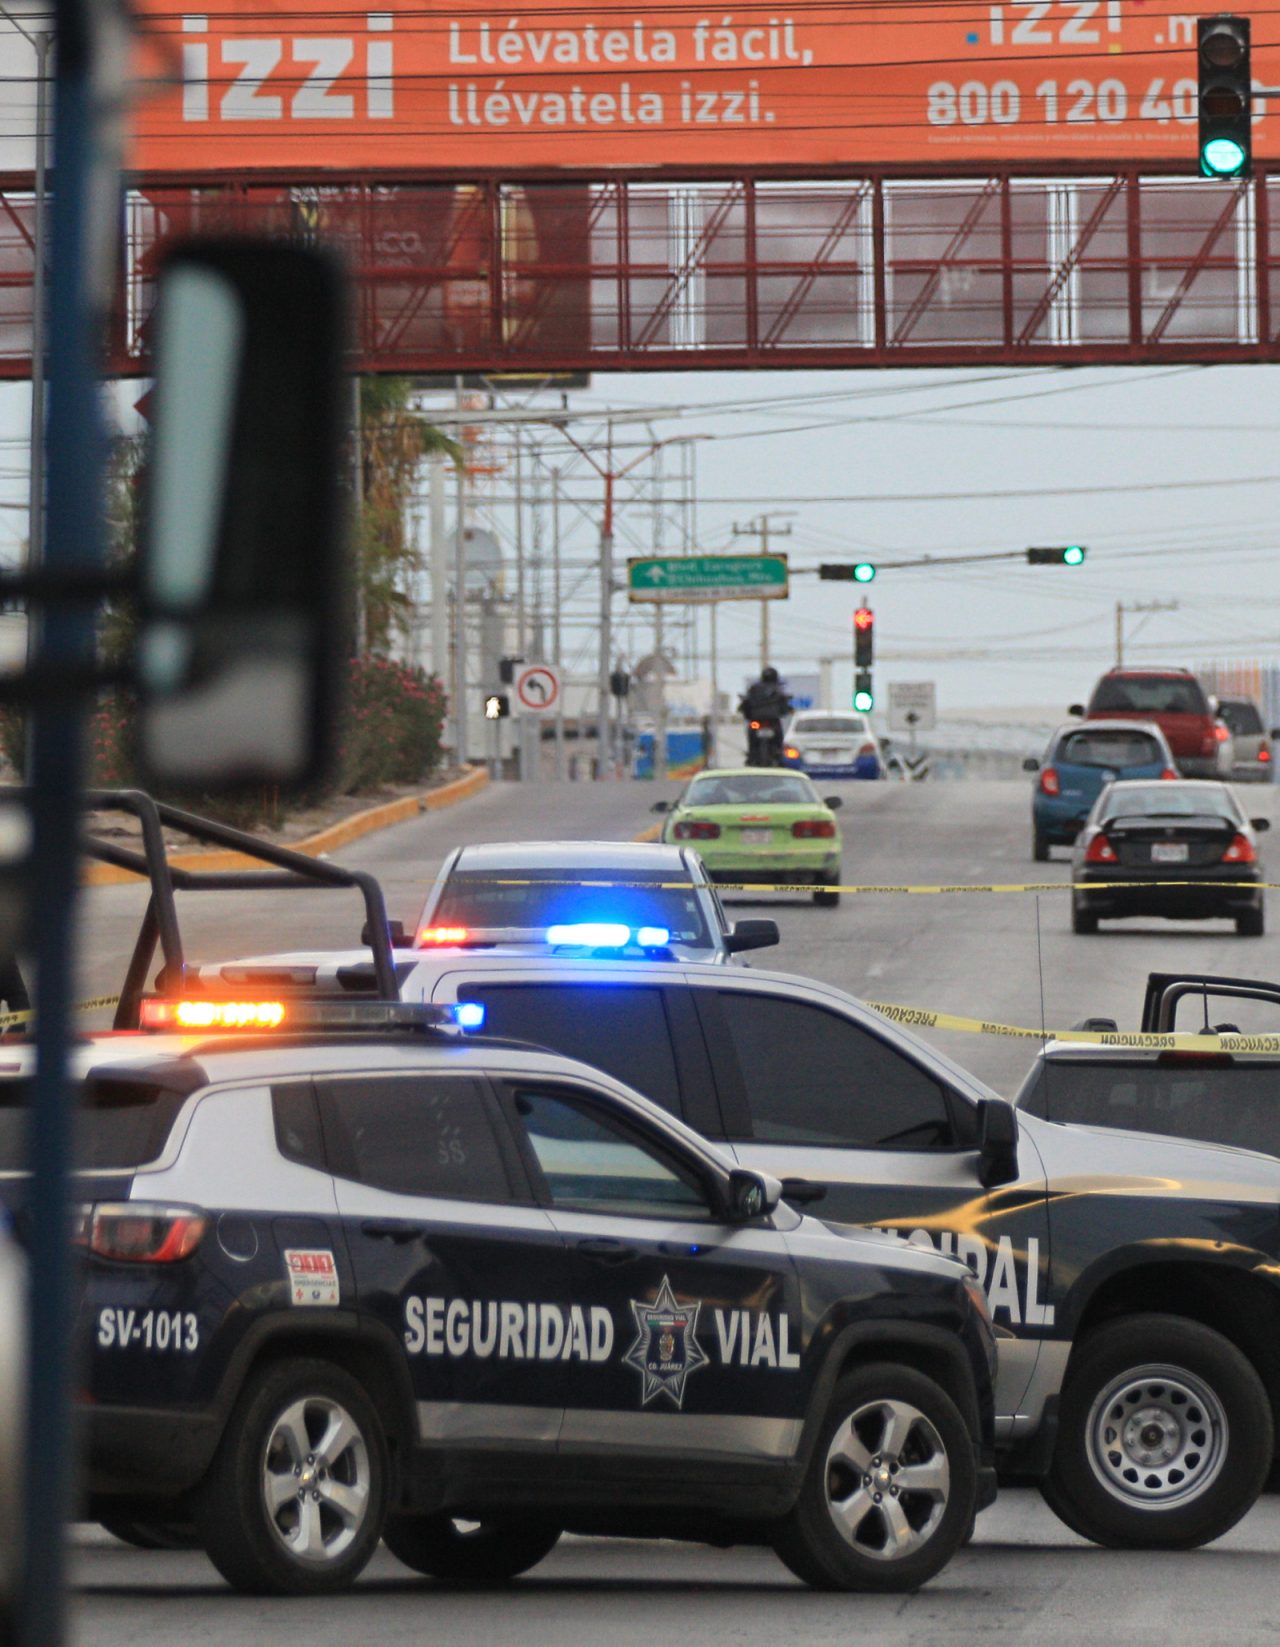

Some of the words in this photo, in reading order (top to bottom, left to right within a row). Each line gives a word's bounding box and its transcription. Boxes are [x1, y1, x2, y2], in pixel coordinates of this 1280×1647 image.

[449, 19, 677, 64] Llévatela
[692, 16, 814, 66] fácil,
[182, 13, 394, 121] izzi
[448, 80, 664, 126] llévatela
[680, 80, 776, 123] izzi.
[927, 80, 1021, 127] 800
[1036, 79, 1128, 126] 120
[98, 1307, 200, 1351] SV-1013
[405, 1296, 615, 1362] SEGURIDAD
[714, 1308, 800, 1369] VIAL
